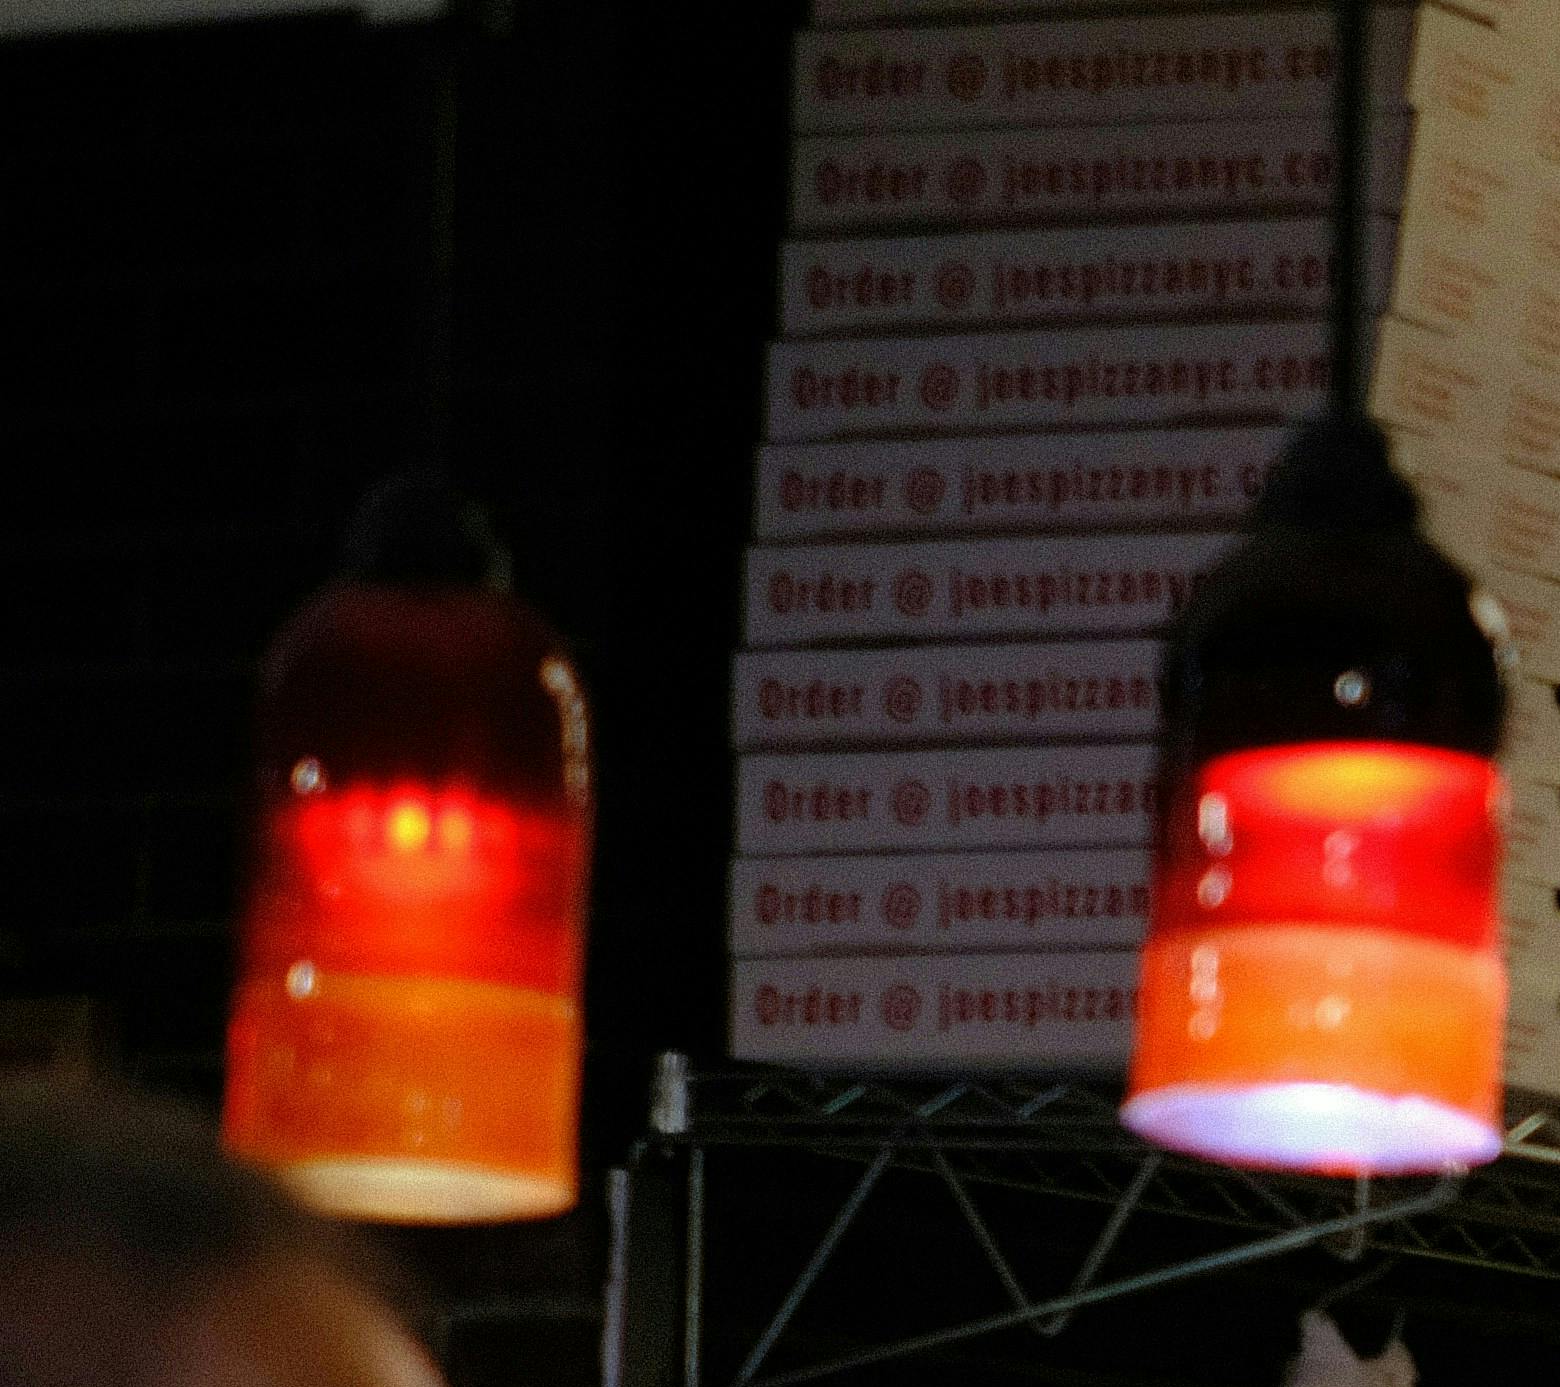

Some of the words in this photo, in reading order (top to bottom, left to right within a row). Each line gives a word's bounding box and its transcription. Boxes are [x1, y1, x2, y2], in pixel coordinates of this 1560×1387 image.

[816, 53, 926, 101] Order
[946, 53, 987, 103] @
[1003, 42, 1334, 98] joespizzanyc.co
[816, 158, 928, 205] Order
[947, 156, 986, 205] @
[1003, 146, 1332, 205] joespizzanyc.co
[806, 263, 915, 310] Order
[936, 259, 975, 311] @
[994, 251, 1332, 309] joespizzanyc.co
[791, 364, 901, 410] Order
[921, 361, 959, 410] @
[779, 467, 884, 514] Order
[906, 465, 946, 514] @
[962, 458, 1265, 514] joespizzanyc.c
[768, 570, 875, 616] Order
[893, 567, 932, 618] @
[948, 566, 1184, 618] joespizzany
[757, 677, 864, 721] Order
[884, 675, 923, 723] @
[939, 671, 1152, 723] joespizzan
[763, 779, 871, 824] Order
[891, 778, 930, 826] @
[947, 776, 1155, 826] joespizzan
[755, 883, 860, 925] Order
[882, 881, 922, 929] @
[938, 879, 1150, 930] joespizzan
[755, 984, 861, 1026] Order
[882, 983, 922, 1031] @
[938, 981, 1139, 1031] joespizza
